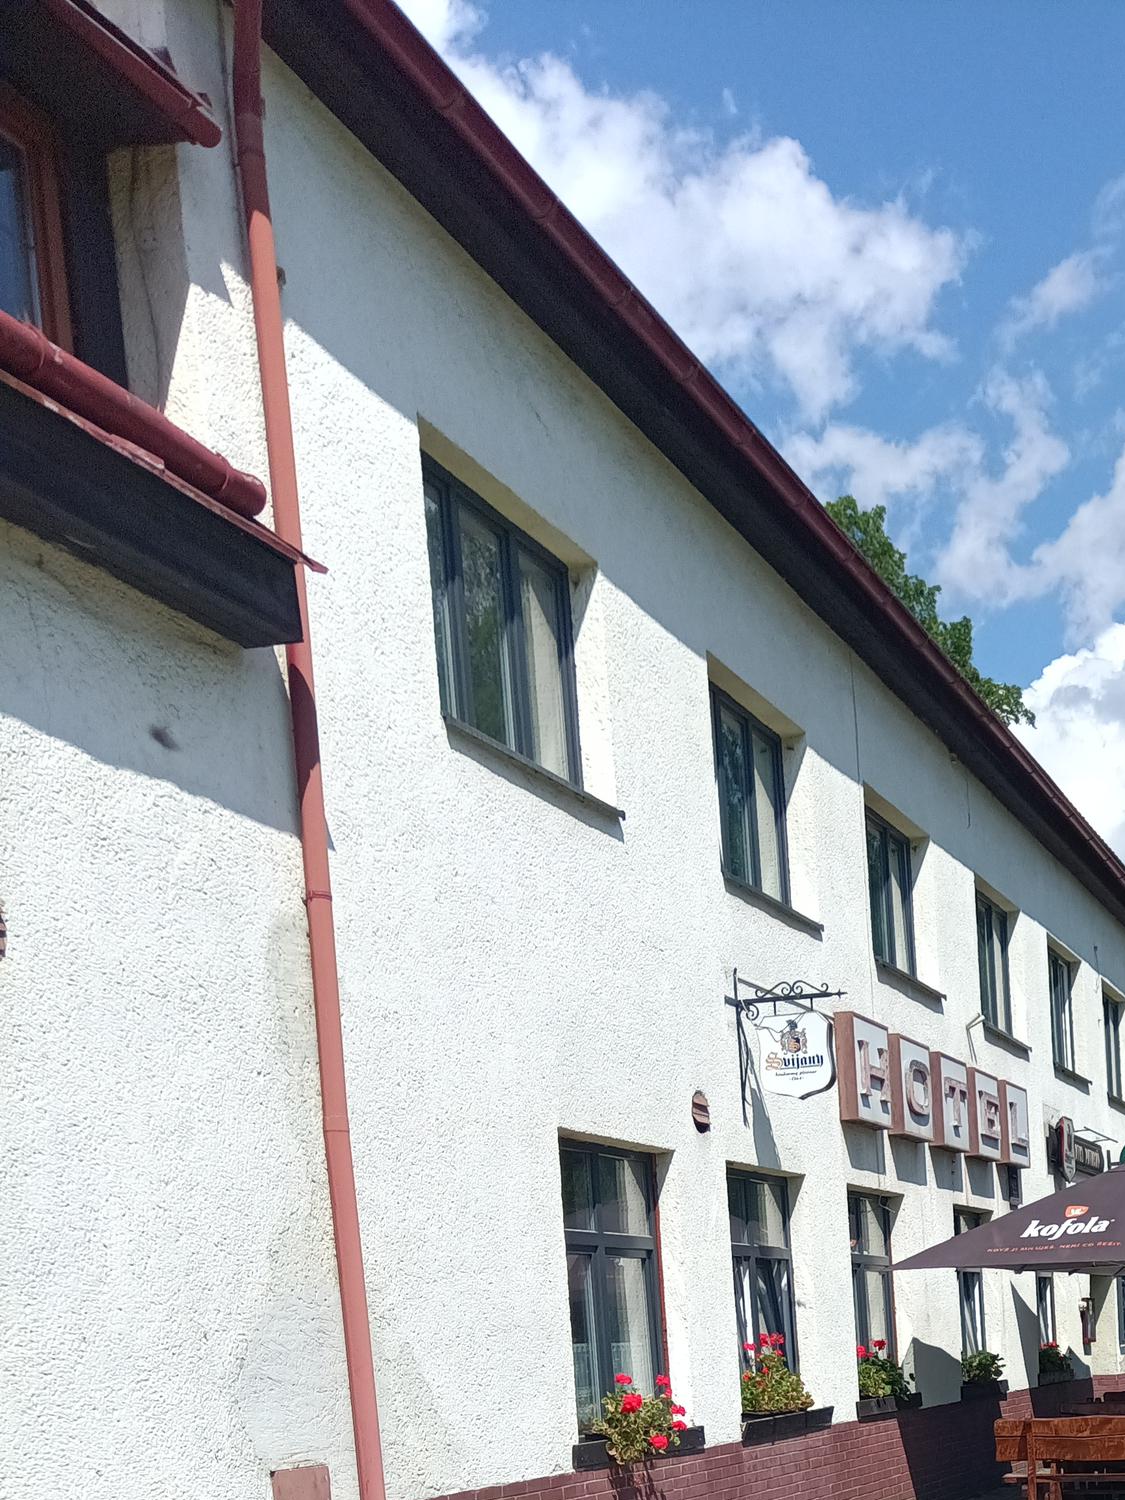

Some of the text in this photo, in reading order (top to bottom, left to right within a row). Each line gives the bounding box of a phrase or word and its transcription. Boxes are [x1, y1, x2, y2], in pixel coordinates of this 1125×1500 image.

[765, 1052, 824, 1071] Svijany
[857, 1039, 1029, 1148] HOTEL
[1020, 1216, 1111, 1241] kofola
